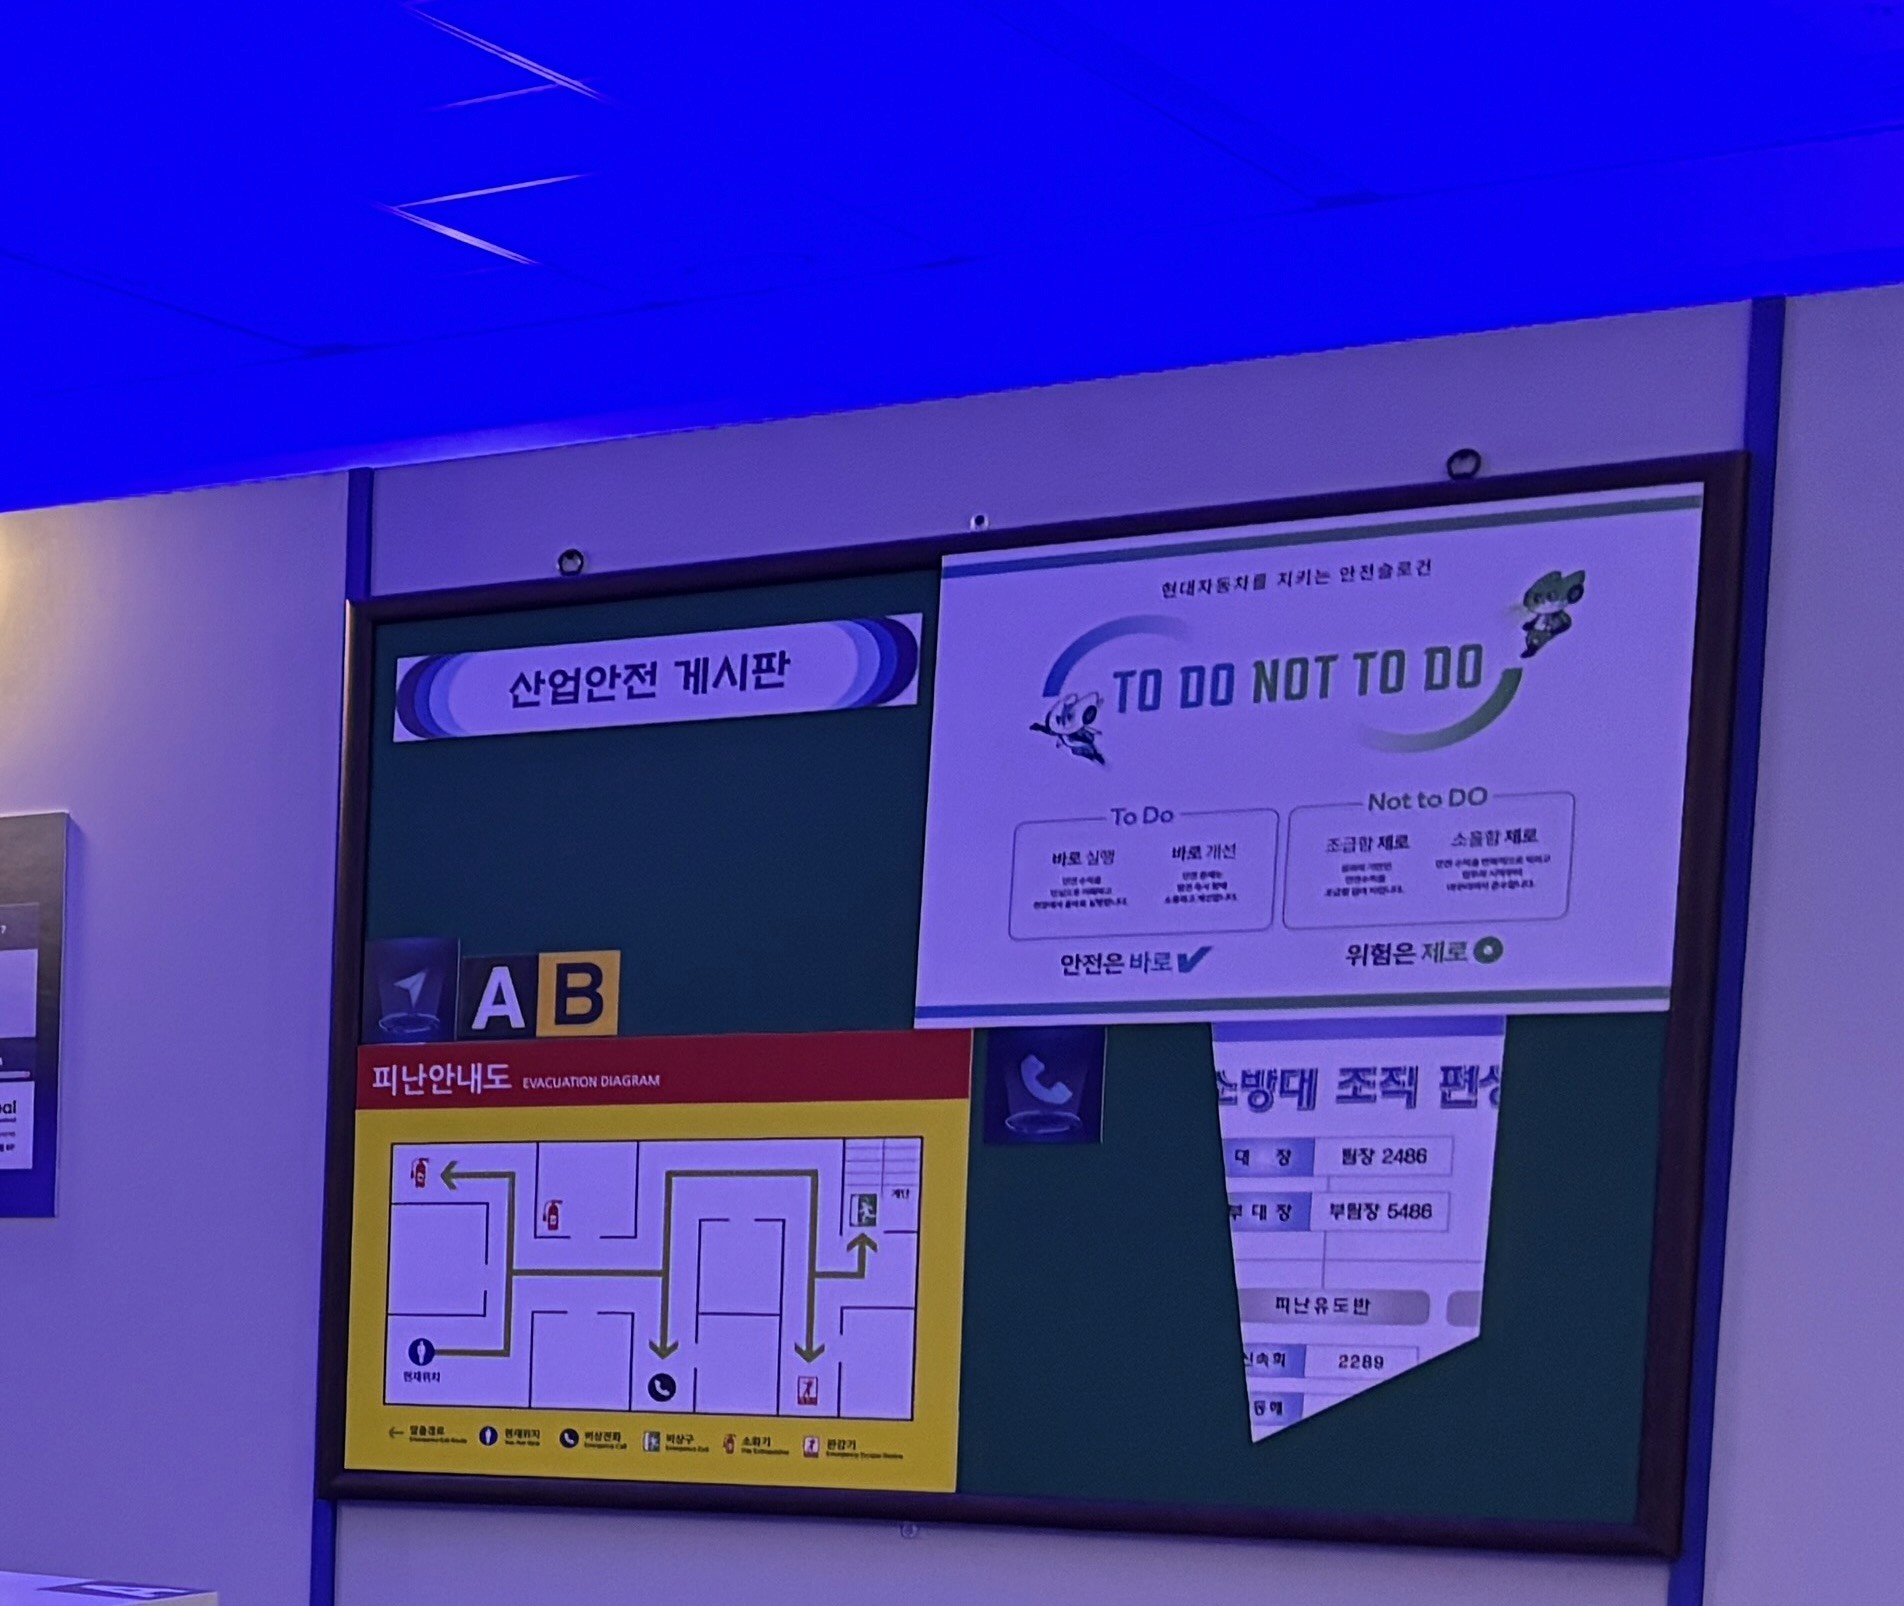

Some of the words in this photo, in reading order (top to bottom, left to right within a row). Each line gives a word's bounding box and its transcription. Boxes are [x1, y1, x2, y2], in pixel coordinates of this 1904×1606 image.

[1161, 572, 1267, 598] 현대자동차를
[1277, 567, 1330, 587] 지키는
[1339, 559, 1432, 581] 안전슬로건
[510, 661, 658, 707] 산업안전
[674, 651, 790, 694] 게시판
[1114, 669, 1161, 713] TO
[1180, 663, 1234, 706] DO
[1253, 655, 1337, 703] NOT
[1353, 650, 1404, 694] TO
[1424, 644, 1483, 689] DO
[1368, 792, 1412, 812] Not
[1417, 791, 1442, 809] to
[1448, 786, 1488, 807] DO
[1111, 808, 1137, 826] To
[1143, 806, 1174, 824] Do
[1377, 834, 1410, 851] 제로
[1505, 828, 1538, 845] 제로
[1052, 852, 1081, 867] 바로
[1172, 845, 1202, 862] 바로
[1061, 953, 1125, 976] 안전은
[1129, 951, 1172, 974] 바로
[1346, 942, 1416, 966] 위험은
[1421, 941, 1467, 963] 제로
[471, 966, 526, 1030] A
[555, 962, 603, 1025] B
[372, 1062, 513, 1096] 피난안내도
[523, 1075, 598, 1089] EVACUATION
[600, 1074, 661, 1088] DIAGRAM
[1336, 1065, 1418, 1110] 조직
[1382, 1147, 1428, 1165] 2486
[1387, 1202, 1432, 1220] 5486
[1275, 1296, 1371, 1316] 피난유도반
[1338, 1354, 1384, 1370] 2289
